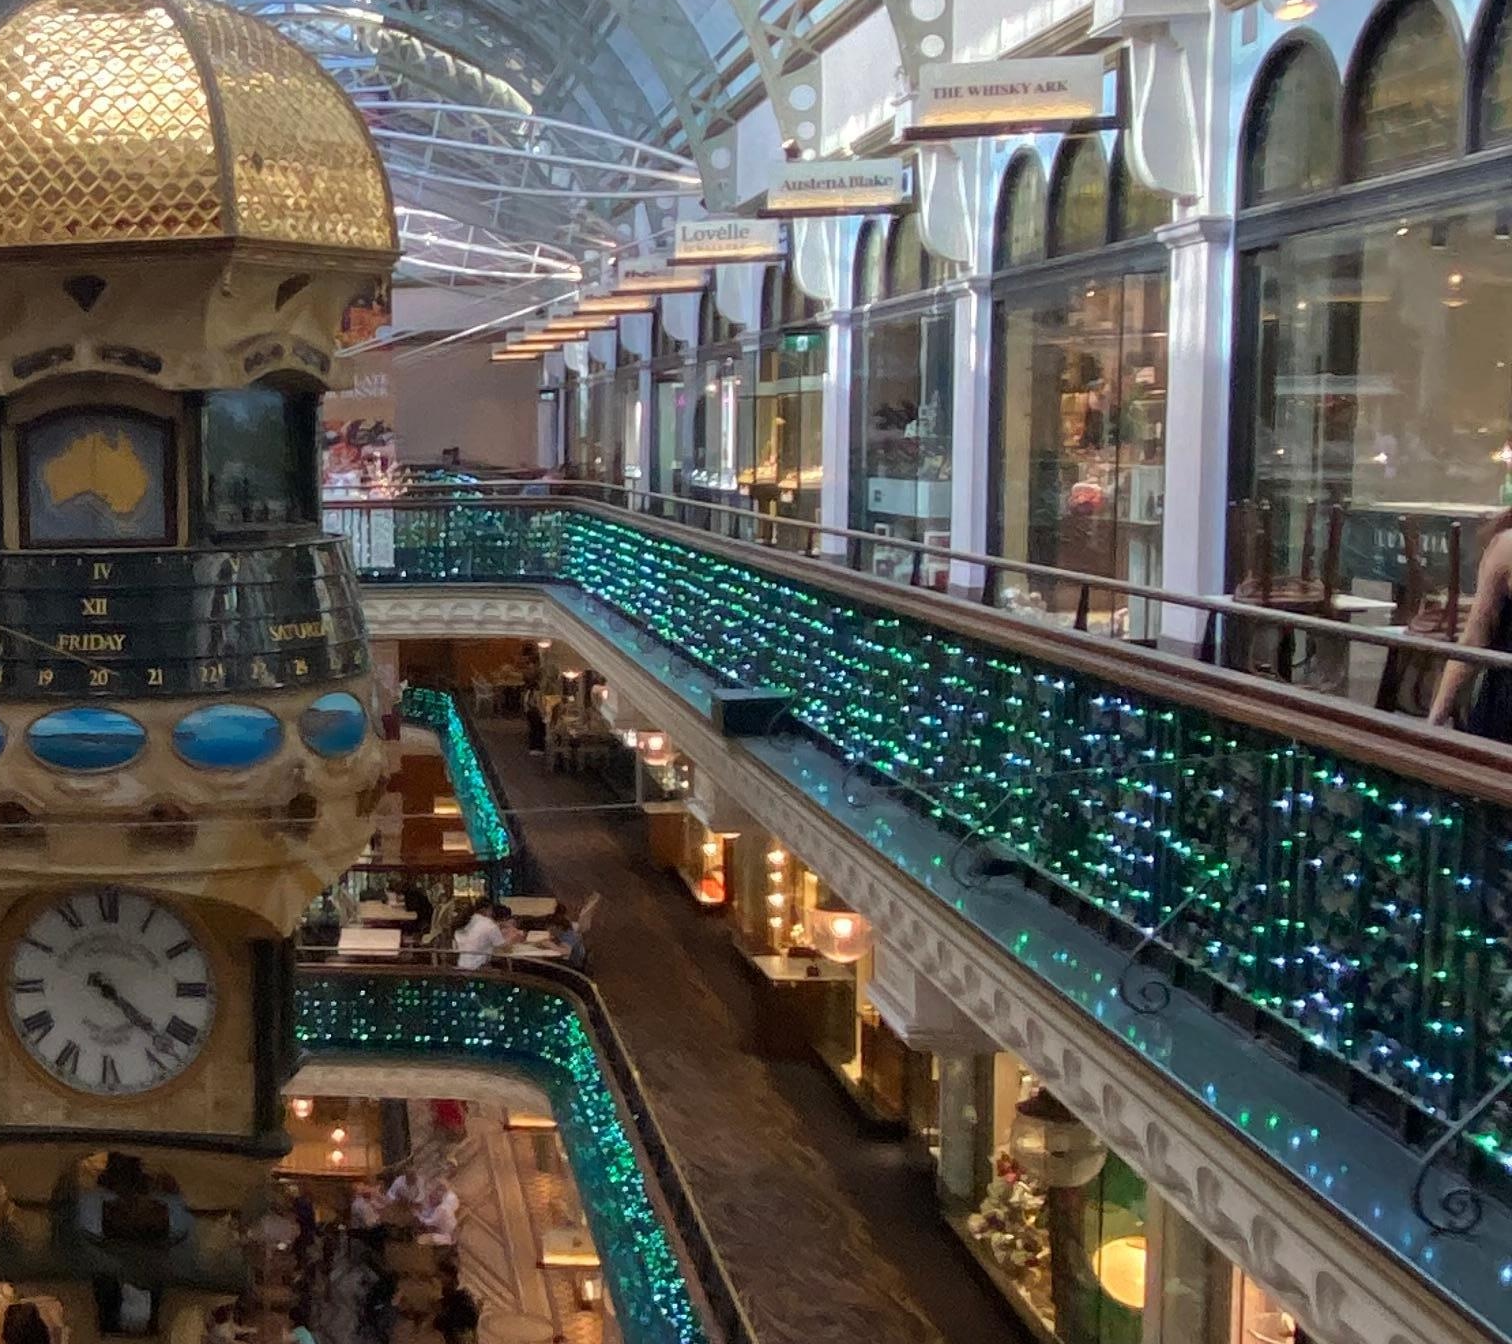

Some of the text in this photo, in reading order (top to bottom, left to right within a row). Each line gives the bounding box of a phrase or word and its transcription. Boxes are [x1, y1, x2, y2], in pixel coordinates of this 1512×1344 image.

[933, 80, 1068, 99] THE WHISKY ARK
[93, 562, 112, 580] IV
[81, 597, 107, 616] XII
[55, 633, 126, 651] FRIDAY
[89, 668, 108, 686] 20
